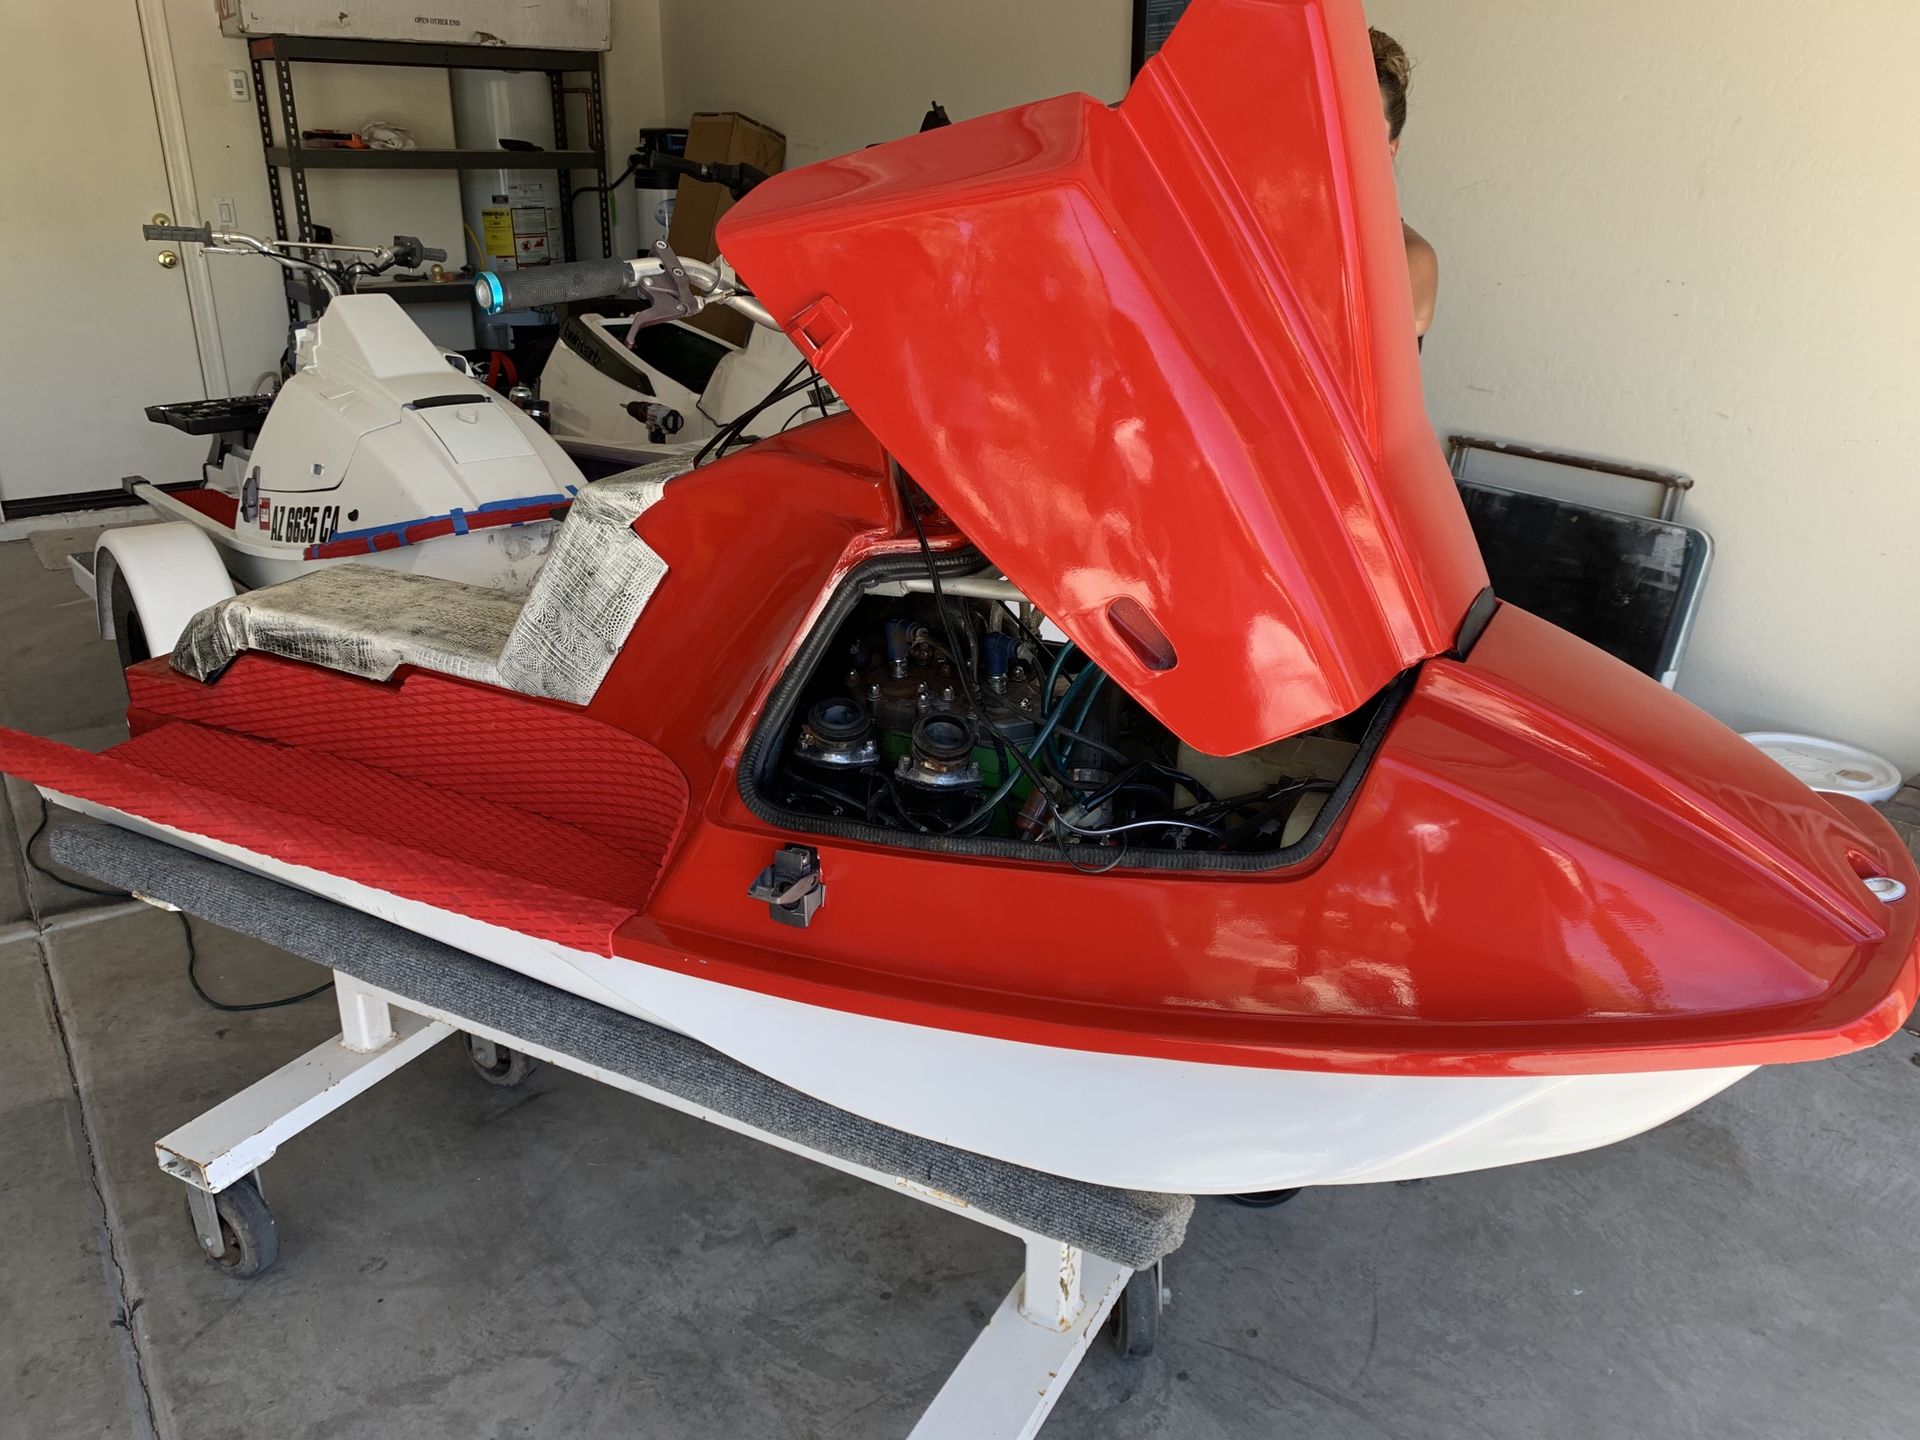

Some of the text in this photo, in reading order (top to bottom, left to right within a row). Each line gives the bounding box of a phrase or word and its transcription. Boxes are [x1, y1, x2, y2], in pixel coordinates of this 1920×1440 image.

[271, 506, 285, 541] AZ
[286, 506, 320, 543] 6635
[319, 506, 340, 542] CA
